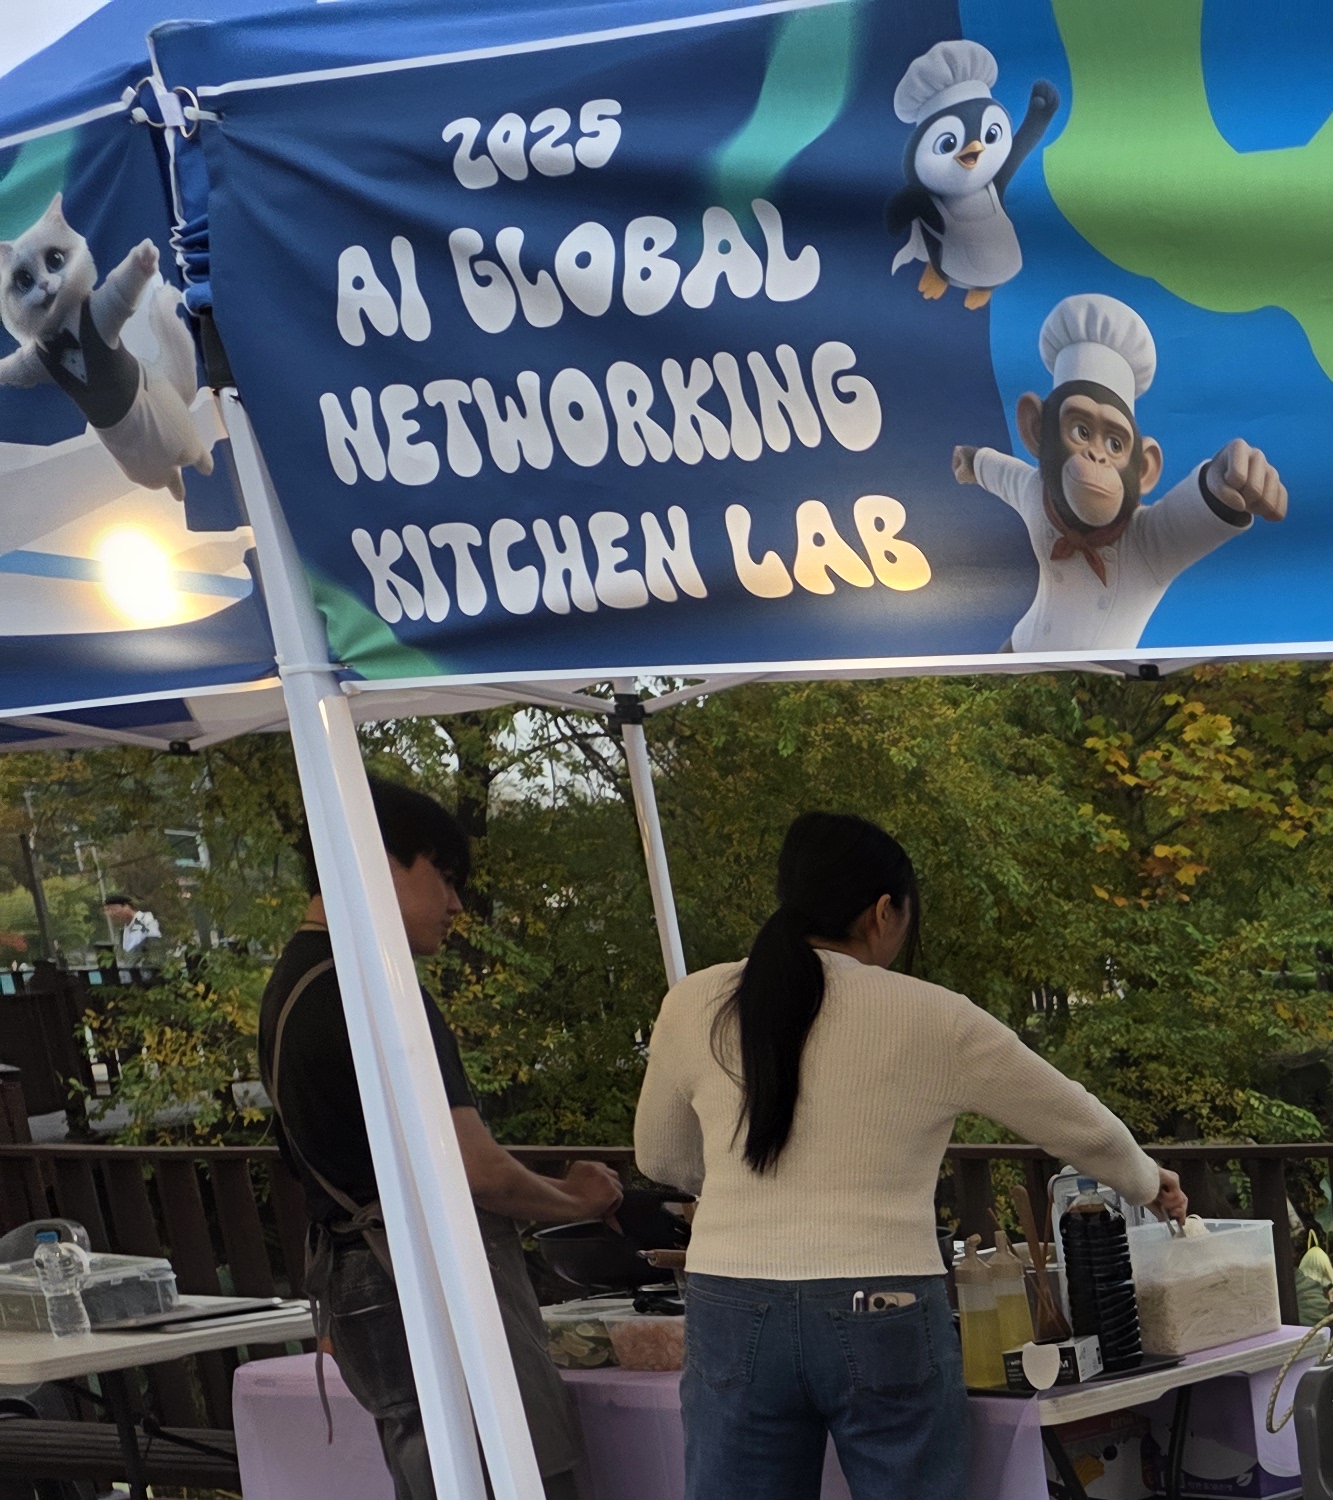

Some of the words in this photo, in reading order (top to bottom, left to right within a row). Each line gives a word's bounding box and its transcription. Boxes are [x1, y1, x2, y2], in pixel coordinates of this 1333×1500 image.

[441, 98, 623, 191] 2025
[335, 236, 432, 347] AI
[448, 198, 821, 335] GLOBAL
[320, 340, 884, 487] NETWORKING
[351, 505, 708, 624] KITCHEN
[725, 494, 933, 599] LAB
